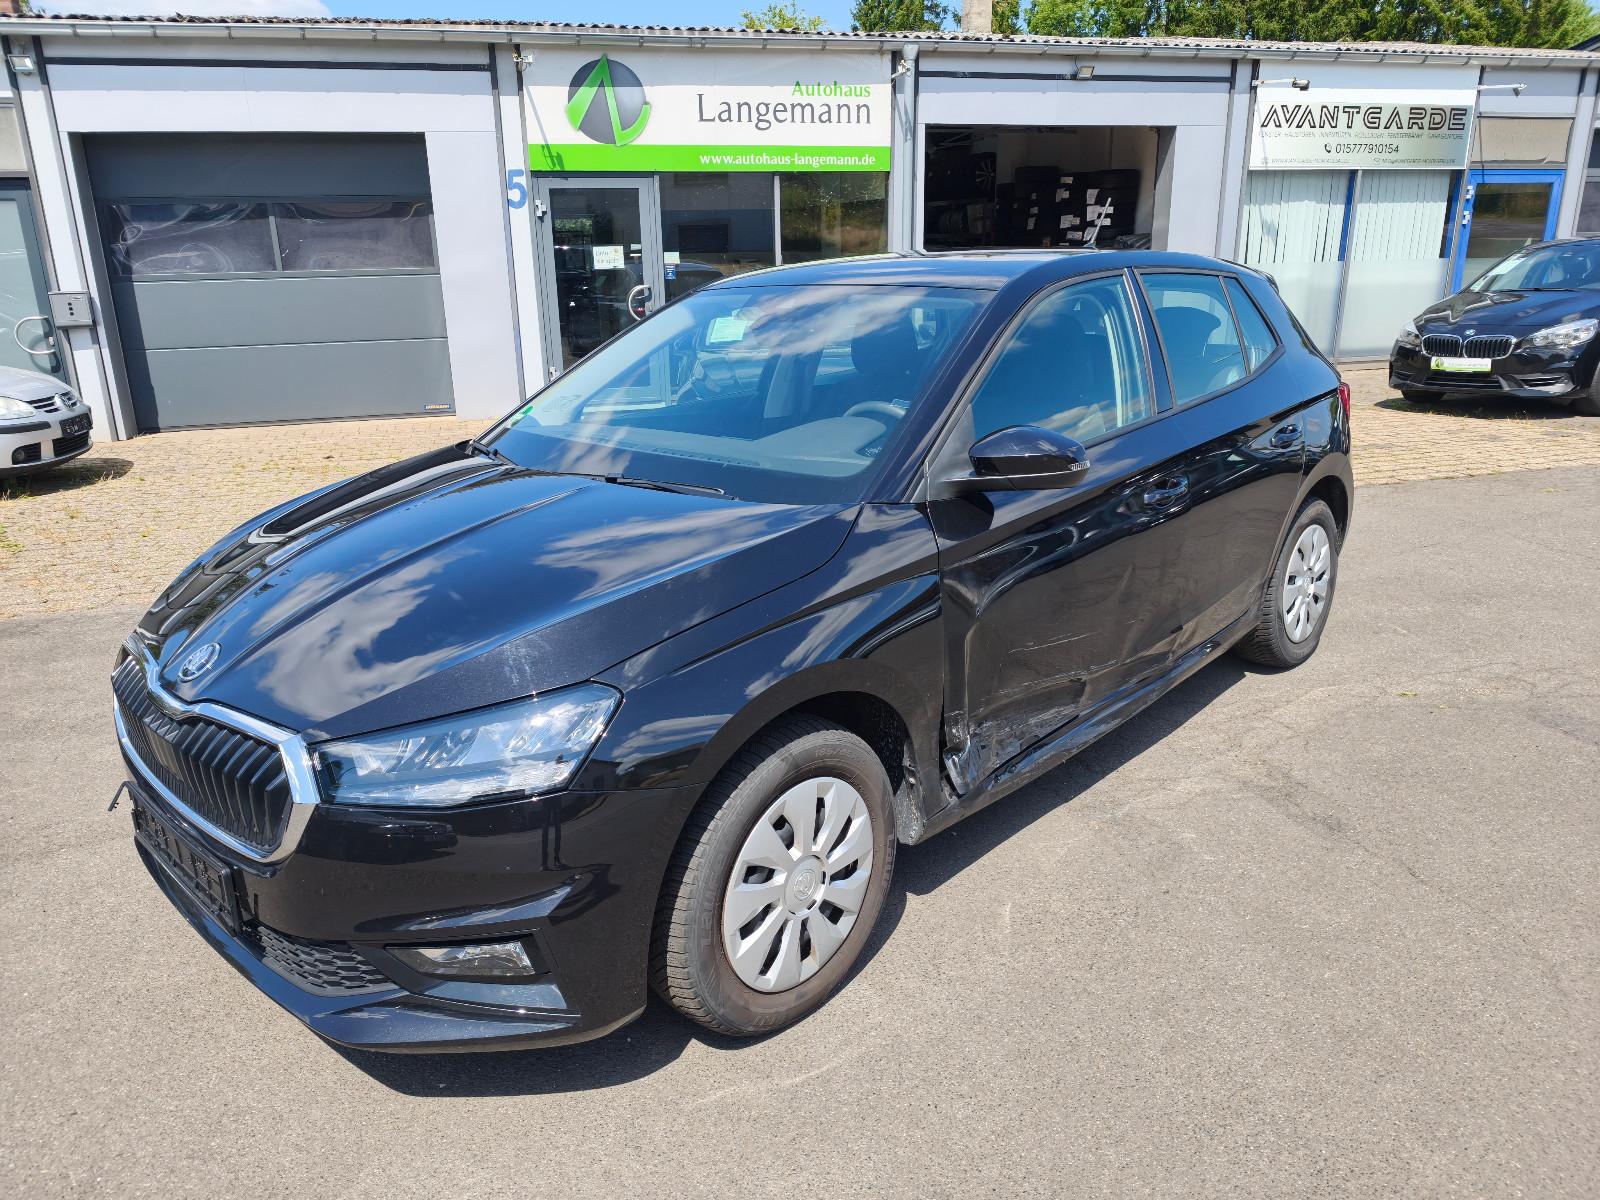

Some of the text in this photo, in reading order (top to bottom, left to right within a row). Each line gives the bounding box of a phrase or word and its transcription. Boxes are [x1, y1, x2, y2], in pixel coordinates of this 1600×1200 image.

[792, 80, 871, 97] Autohaus
[697, 93, 871, 131] Langemann
[1261, 105, 1467, 131] AVANTGARDE
[1335, 143, 1399, 154] 015777910154
[699, 152, 876, 168] www.autohaus-langemann.de
[507, 169, 528, 209] 5
